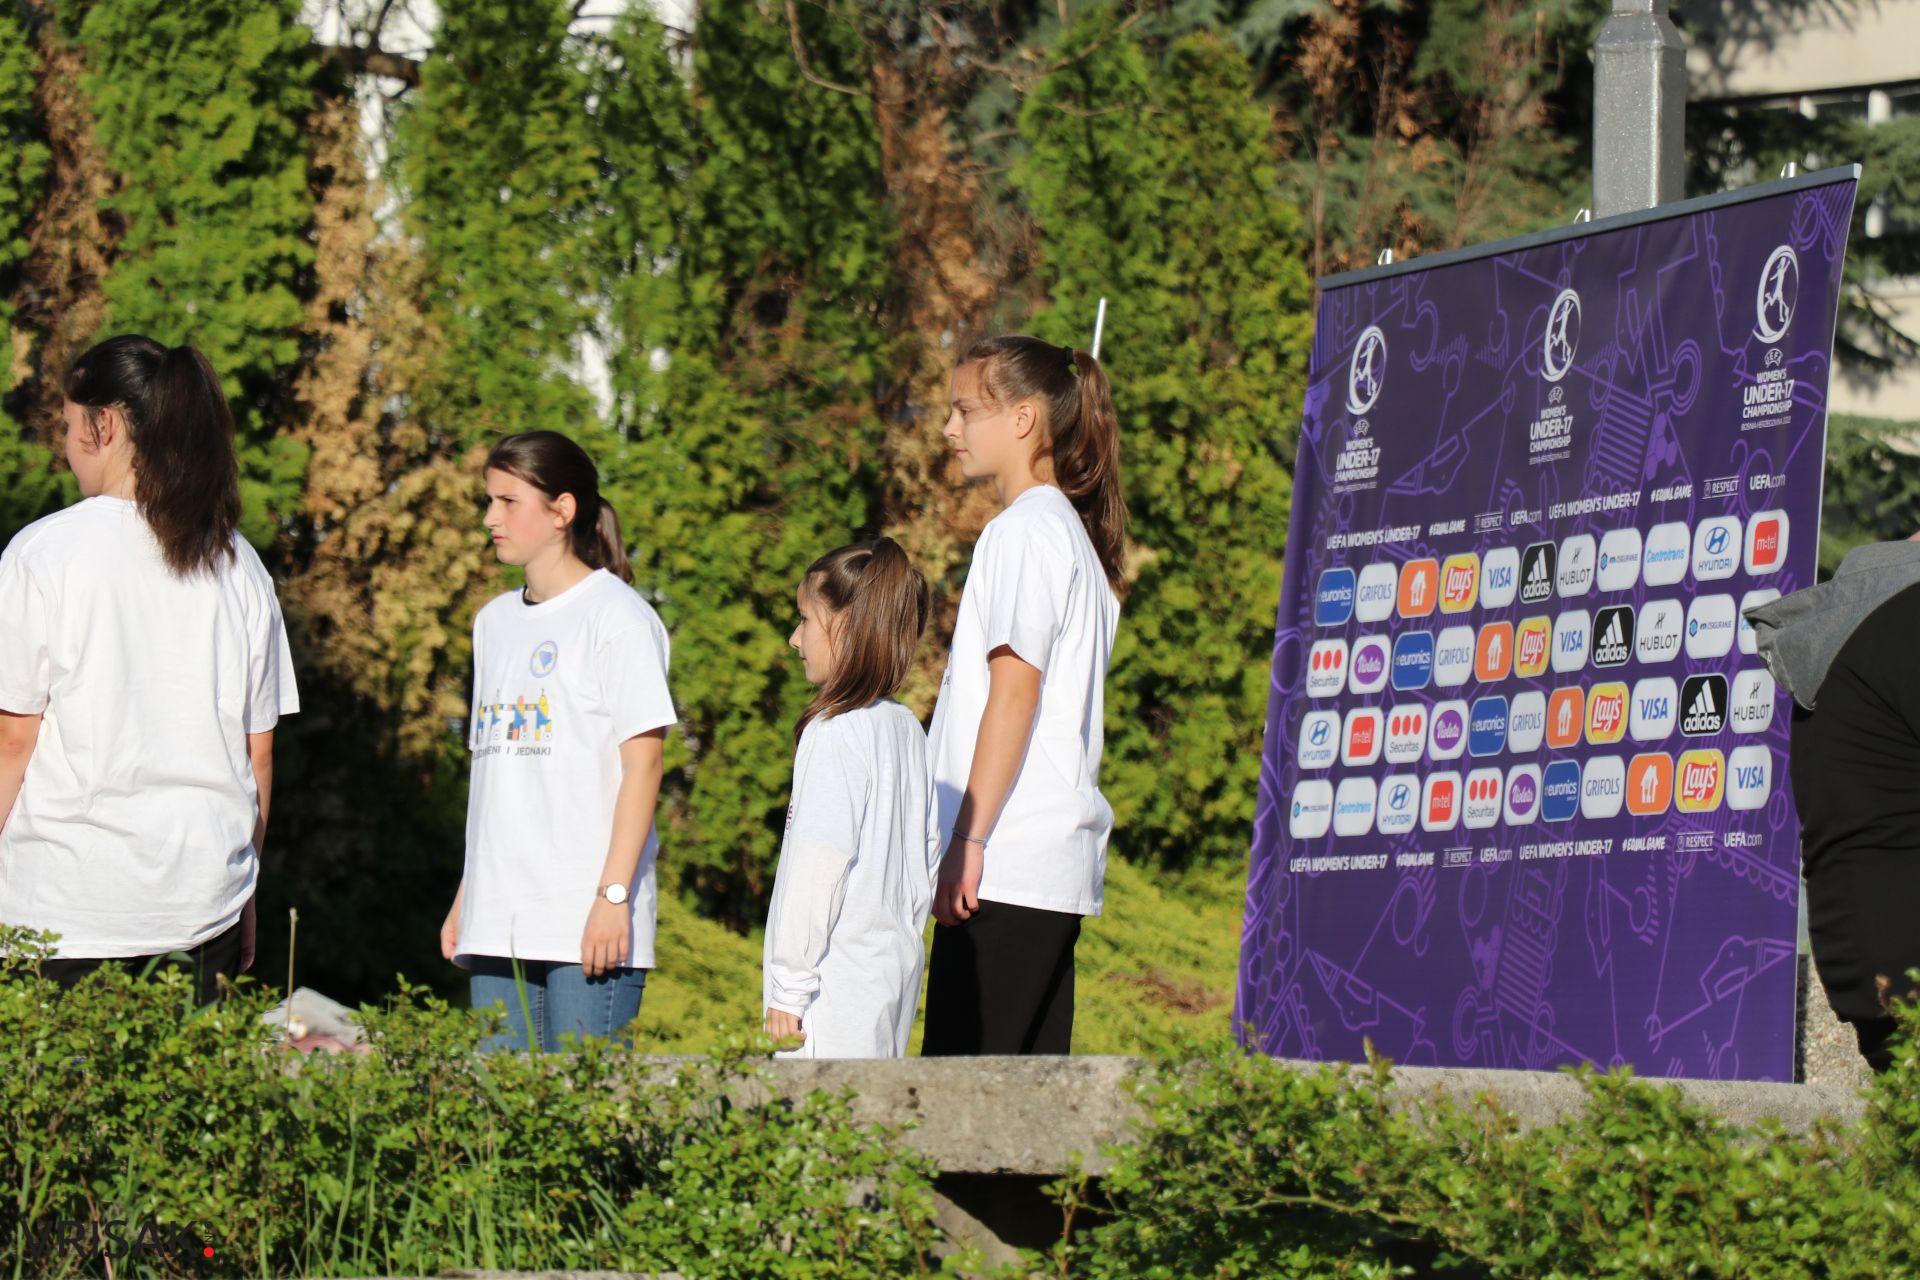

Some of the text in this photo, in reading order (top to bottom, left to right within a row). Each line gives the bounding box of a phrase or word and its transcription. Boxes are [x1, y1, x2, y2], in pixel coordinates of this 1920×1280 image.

[1756, 368, 1787, 384] WOMEN'S
[1744, 379, 1795, 405] UNDER-17
[1540, 405, 1567, 420] WOMEN'S
[1742, 400, 1792, 418] CHAMPIONSHIP
[1530, 415, 1574, 440] UNDER-17
[1346, 437, 1374, 450] WOMEN'S
[1530, 435, 1572, 452] CHAMPIONSHIP
[1336, 448, 1381, 470] UNDER-17
[1334, 466, 1379, 482] CHAMPIONSHIP
[1750, 474, 1786, 490] UEFA.com
[1712, 480, 1739, 494] RESPECT
[1548, 491, 1641, 520] UEFA WOMEN'S UNDER-17
[1480, 516, 1503, 528] RESPECT
[1510, 510, 1542, 526] UEFA.com
[1326, 526, 1421, 550] UEFA WOMEN'S UNDER-17
[1646, 548, 1686, 564] Centrotrans
[1698, 558, 1732, 572] HYUNDAI
[1488, 566, 1512, 589] VISA
[1560, 568, 1591, 586] HUBLOT
[1320, 586, 1352, 602] euronics
[1360, 584, 1392, 602] GRIFOLS
[1523, 579, 1550, 598] adidas
[1560, 630, 1582, 652] VISA
[1640, 634, 1678, 651] HUBLOT
[1400, 650, 1431, 666] euronics
[1438, 647, 1470, 666] GRIFOLS
[1595, 644, 1628, 662] adidas
[1310, 674, 1340, 688] Securitas
[1640, 698, 1668, 720] VISA
[1734, 704, 1770, 721] HUBLOT
[1476, 715, 1505, 732] euronics
[1512, 713, 1542, 732] GRIFOLS
[1684, 712, 1720, 732] adidas
[514, 746, 552, 756] JEDNAKI
[1390, 740, 1419, 754] Securitas
[1549, 779, 1577, 796] euronics
[1586, 778, 1620, 796] GRIFOLS
[1736, 768, 1764, 790] VISA
[1382, 814, 1412, 825] HYUNDAI
[1467, 806, 1495, 818] Securitas
[1685, 835, 1713, 848] RESPECT
[1724, 832, 1762, 848] UEFA.com
[1450, 850, 1472, 864] RESPECT
[1480, 848, 1512, 862] UEFA.com
[1520, 839, 1613, 860] UEFA WOMEN'S UNDER-17
[1290, 854, 1388, 872] UEFA WOMEN'S UNDER-17
